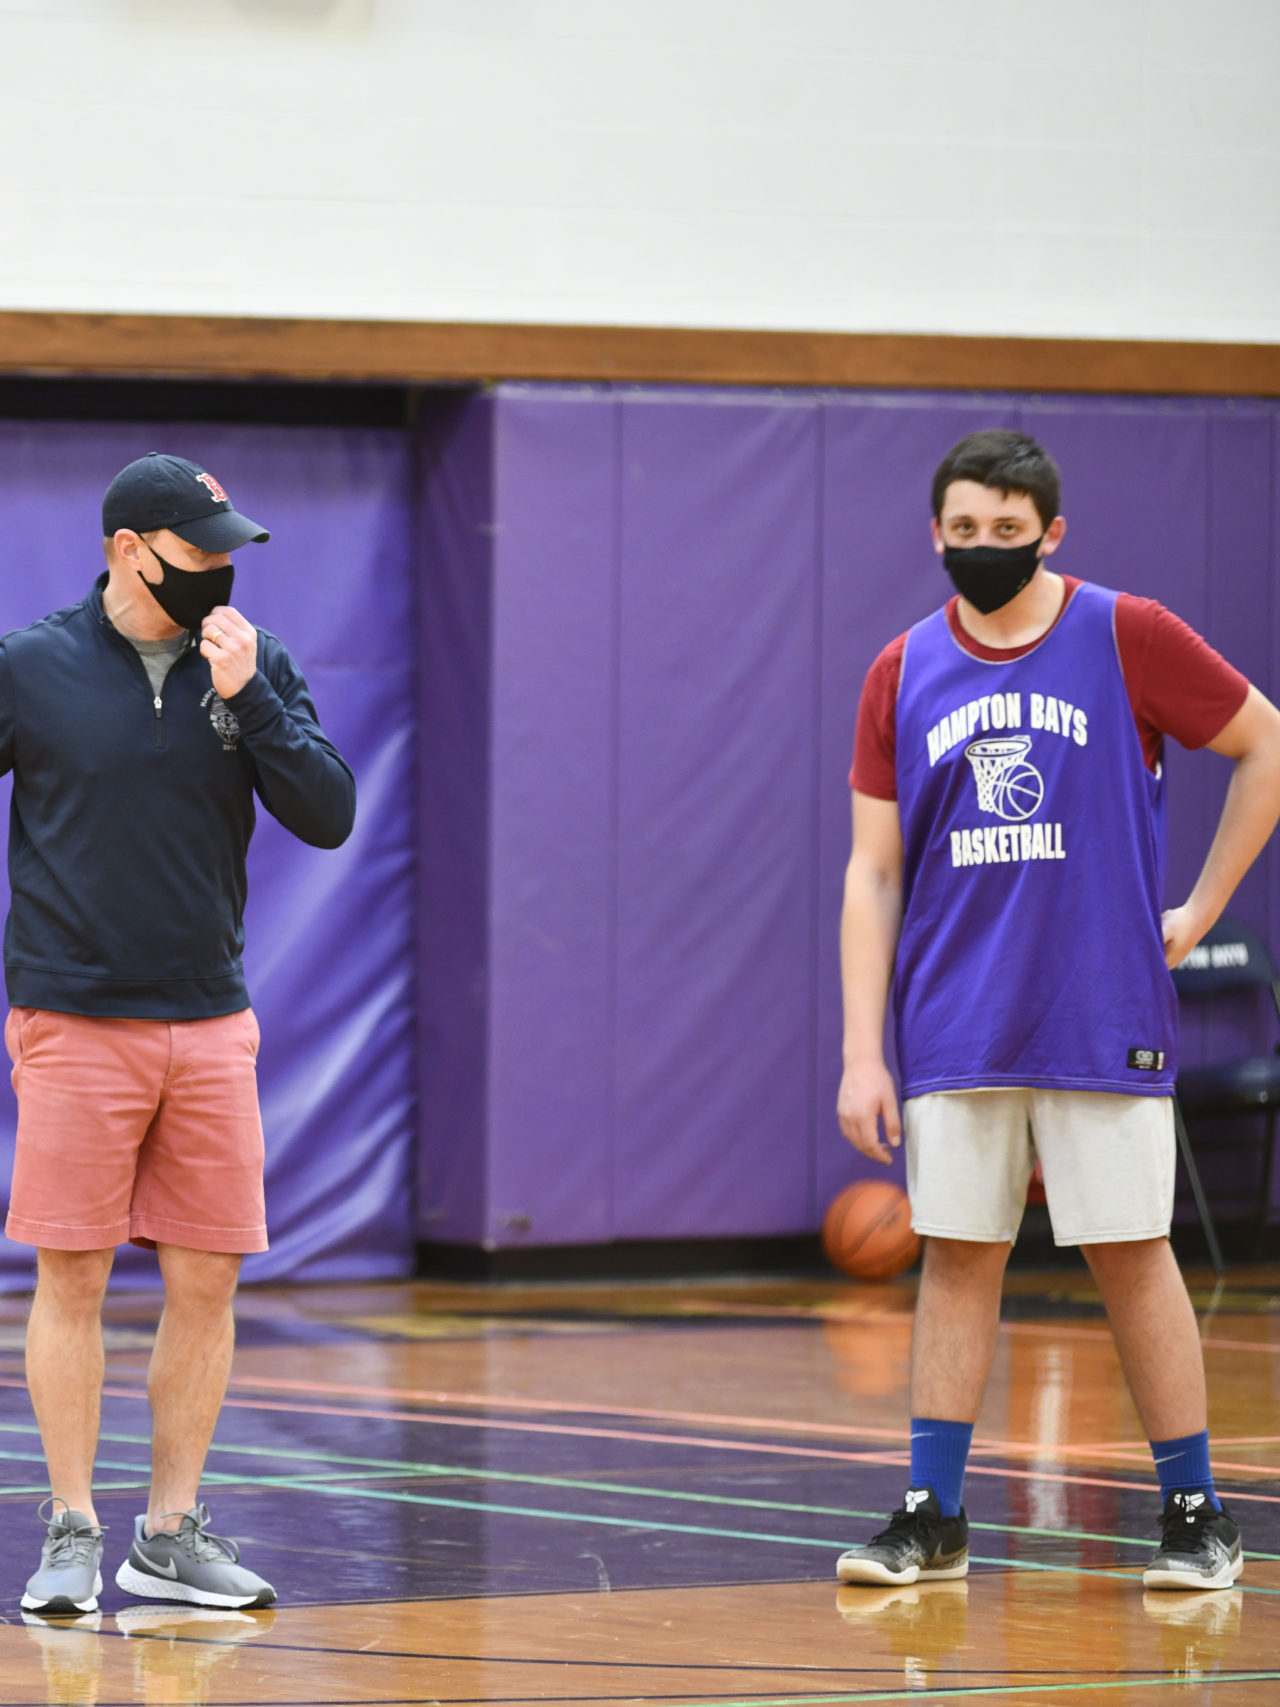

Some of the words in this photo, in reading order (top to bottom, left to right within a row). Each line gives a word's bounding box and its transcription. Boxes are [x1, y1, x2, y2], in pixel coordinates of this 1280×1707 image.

[195, 472, 227, 503] B
[926, 692, 1021, 768] HAMPTON
[1030, 692, 1088, 747] BAYS
[950, 822, 1066, 868] BASKETBALL
